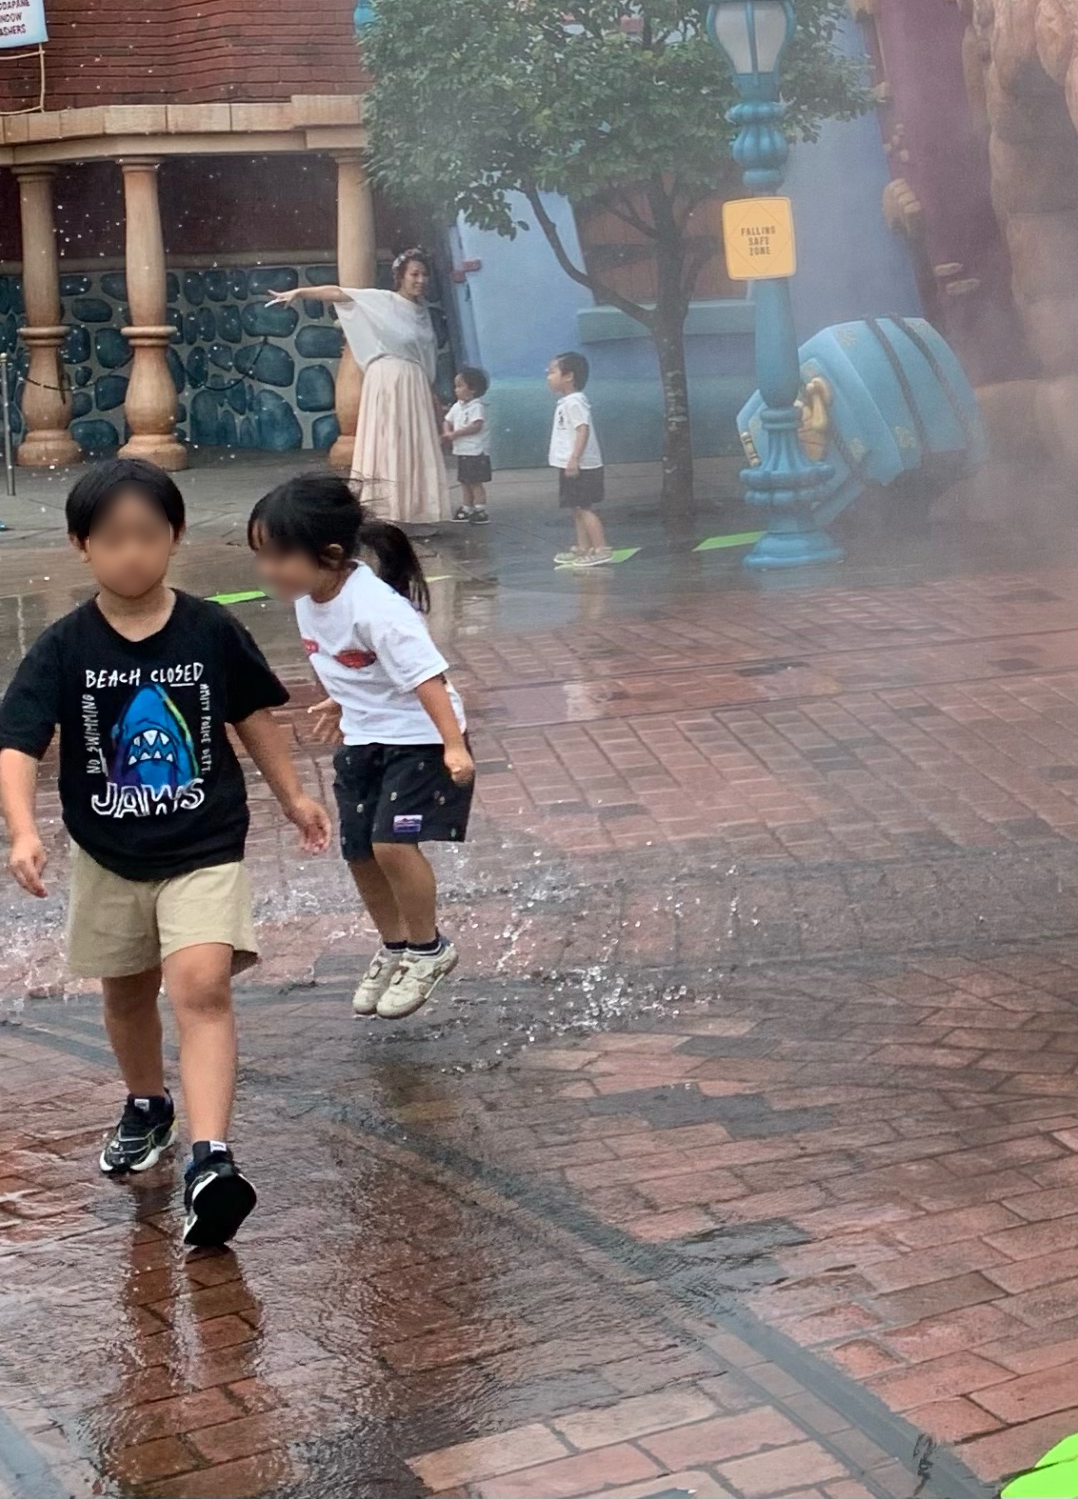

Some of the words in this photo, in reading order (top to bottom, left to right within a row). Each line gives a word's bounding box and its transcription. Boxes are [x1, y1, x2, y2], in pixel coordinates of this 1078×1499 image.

[740, 225, 776, 237] FALLING
[749, 246, 771, 256] ZONE
[85, 668, 141, 689] BEACH
[150, 662, 204, 683] CLOSED
[200, 683, 211, 711] AMITY
[82, 693, 100, 752] SWIMMING
[201, 715, 212, 744] POLICE
[86, 758, 101, 774] NO
[91, 778, 205, 818] JAWS
